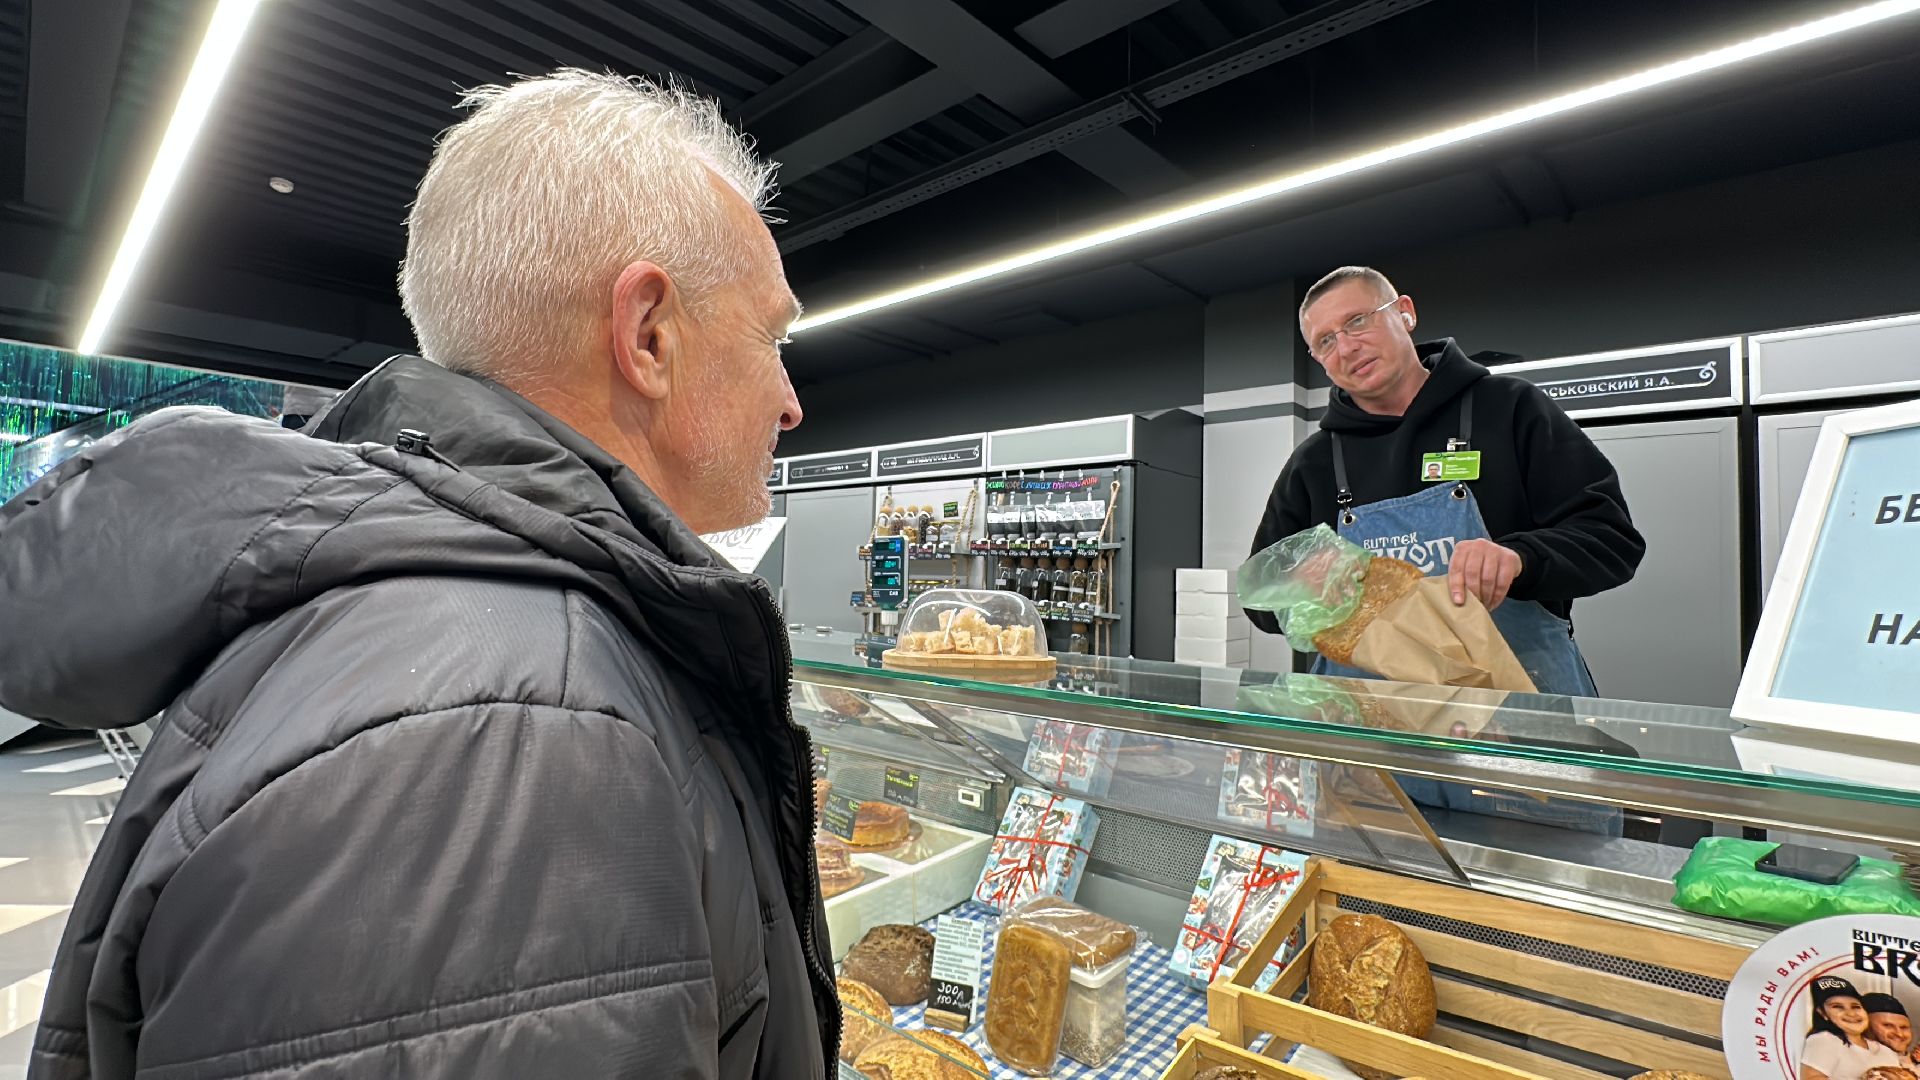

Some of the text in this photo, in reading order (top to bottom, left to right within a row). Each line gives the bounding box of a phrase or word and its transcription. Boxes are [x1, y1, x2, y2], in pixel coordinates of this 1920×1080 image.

[1853, 942, 1920, 987] BR
[1755, 947, 1820, 1063] МЫ РАДЫ ВАМ!
